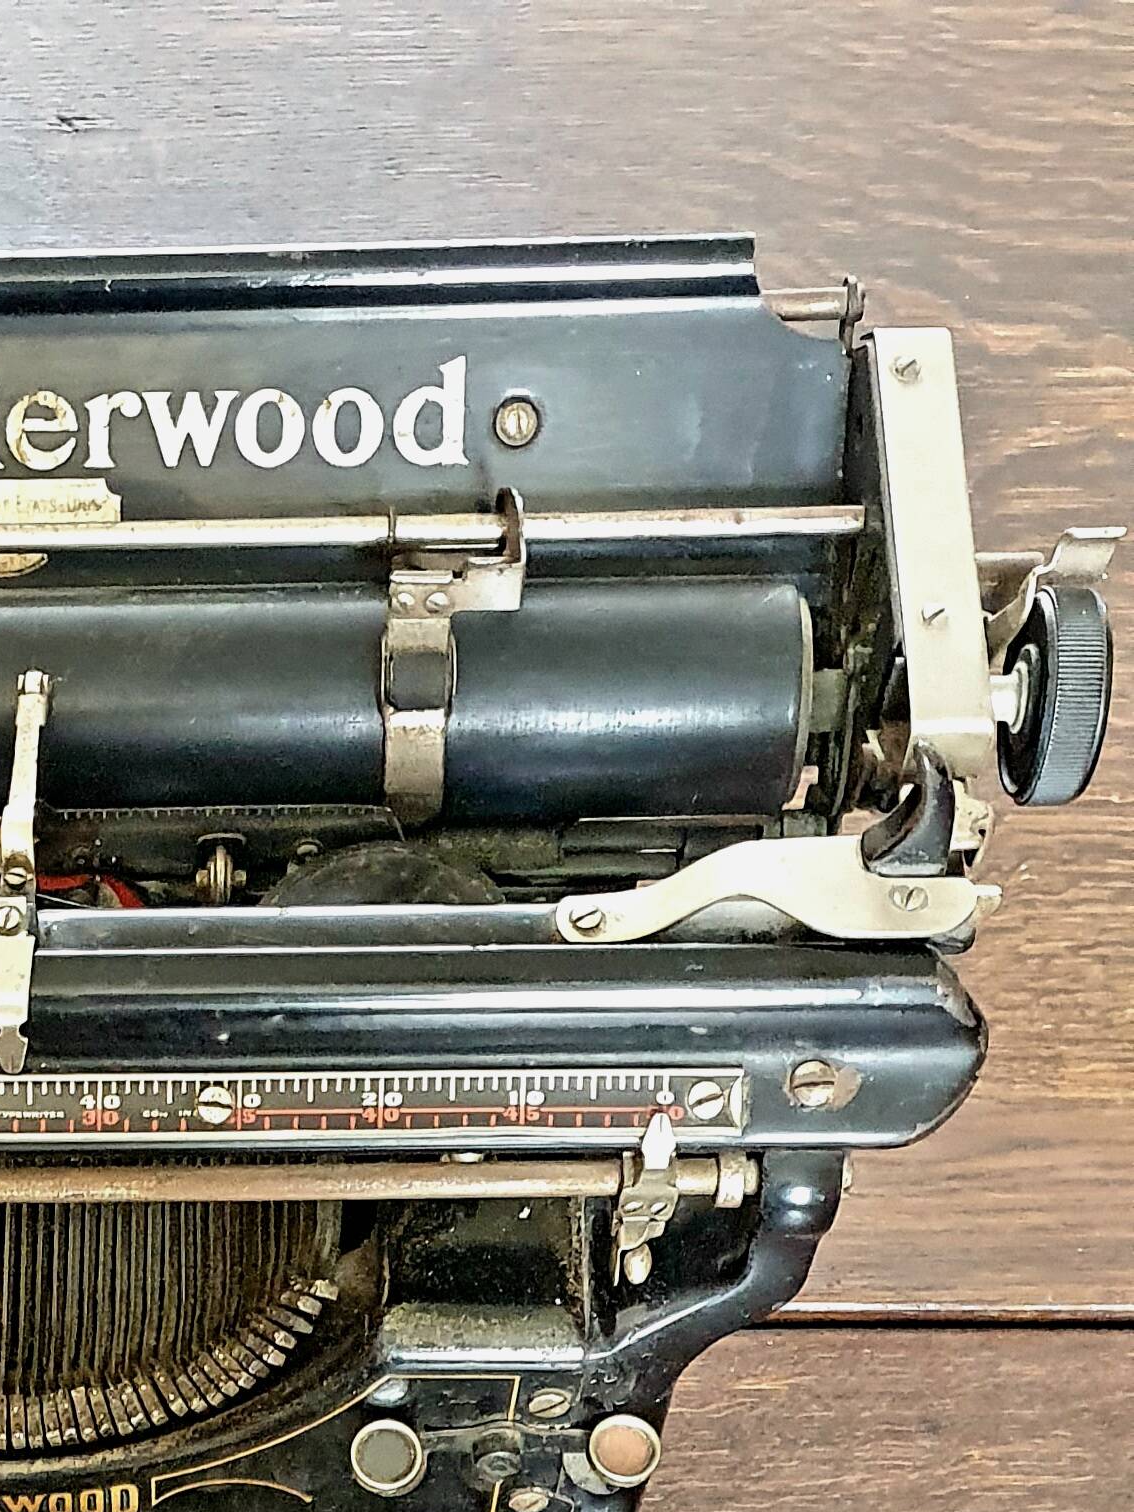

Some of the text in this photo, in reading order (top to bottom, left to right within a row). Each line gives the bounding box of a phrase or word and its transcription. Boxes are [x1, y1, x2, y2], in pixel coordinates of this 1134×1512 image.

[79, 1093, 122, 1110] 40
[361, 1091, 403, 1108] 20
[507, 1090, 545, 1107] 10
[655, 1090, 675, 1105] 0
[81, 1109, 120, 1126] 30
[361, 1107, 401, 1124] 40
[503, 1105, 541, 1122] 45
